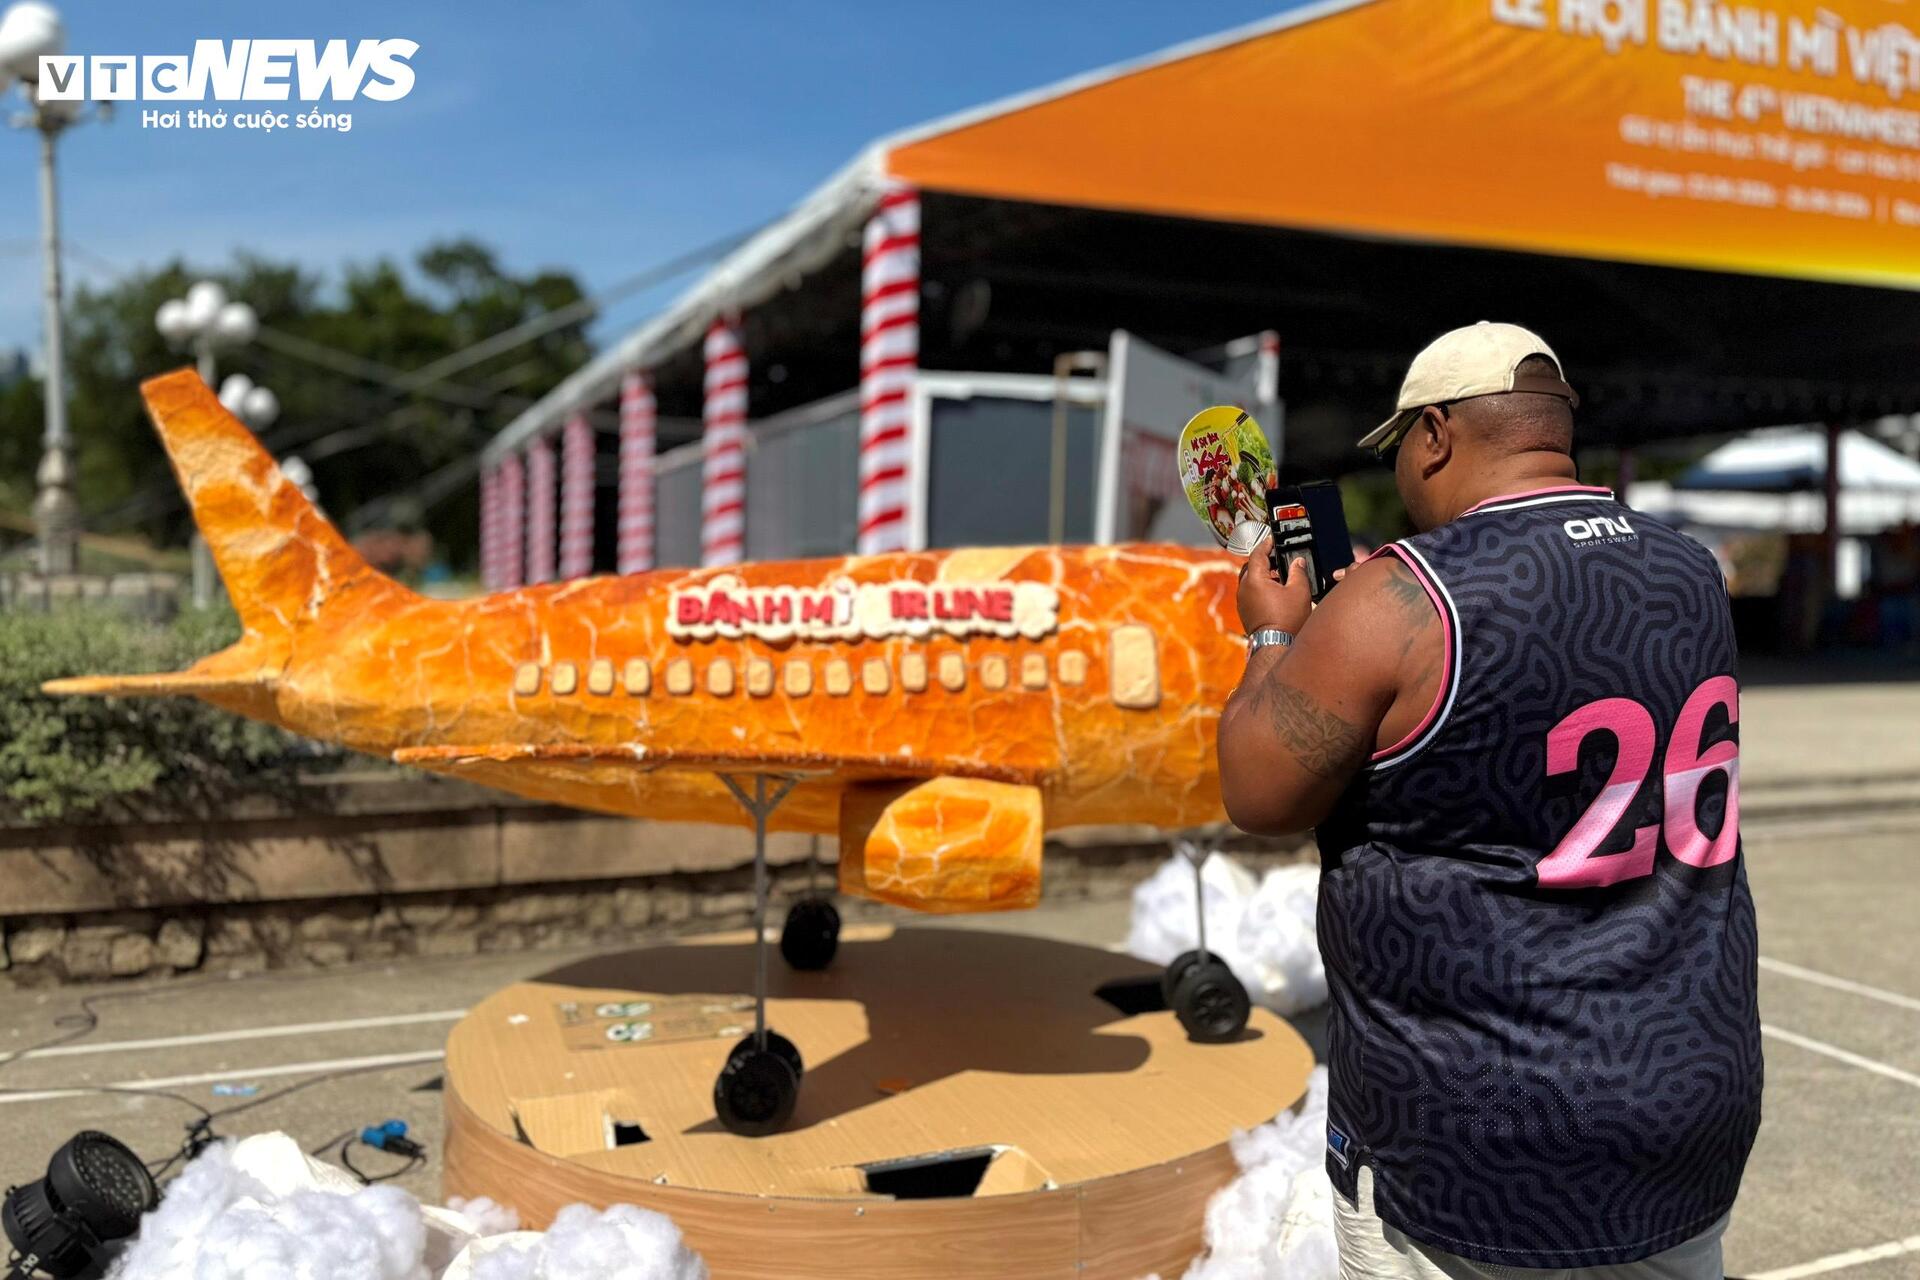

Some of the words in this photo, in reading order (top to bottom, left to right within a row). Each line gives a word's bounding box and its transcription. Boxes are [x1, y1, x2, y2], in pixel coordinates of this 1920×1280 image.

[1681, 74, 1734, 121] THE
[1573, 534, 1639, 549] SPORTSWEAR
[1535, 675, 1739, 888] 26
